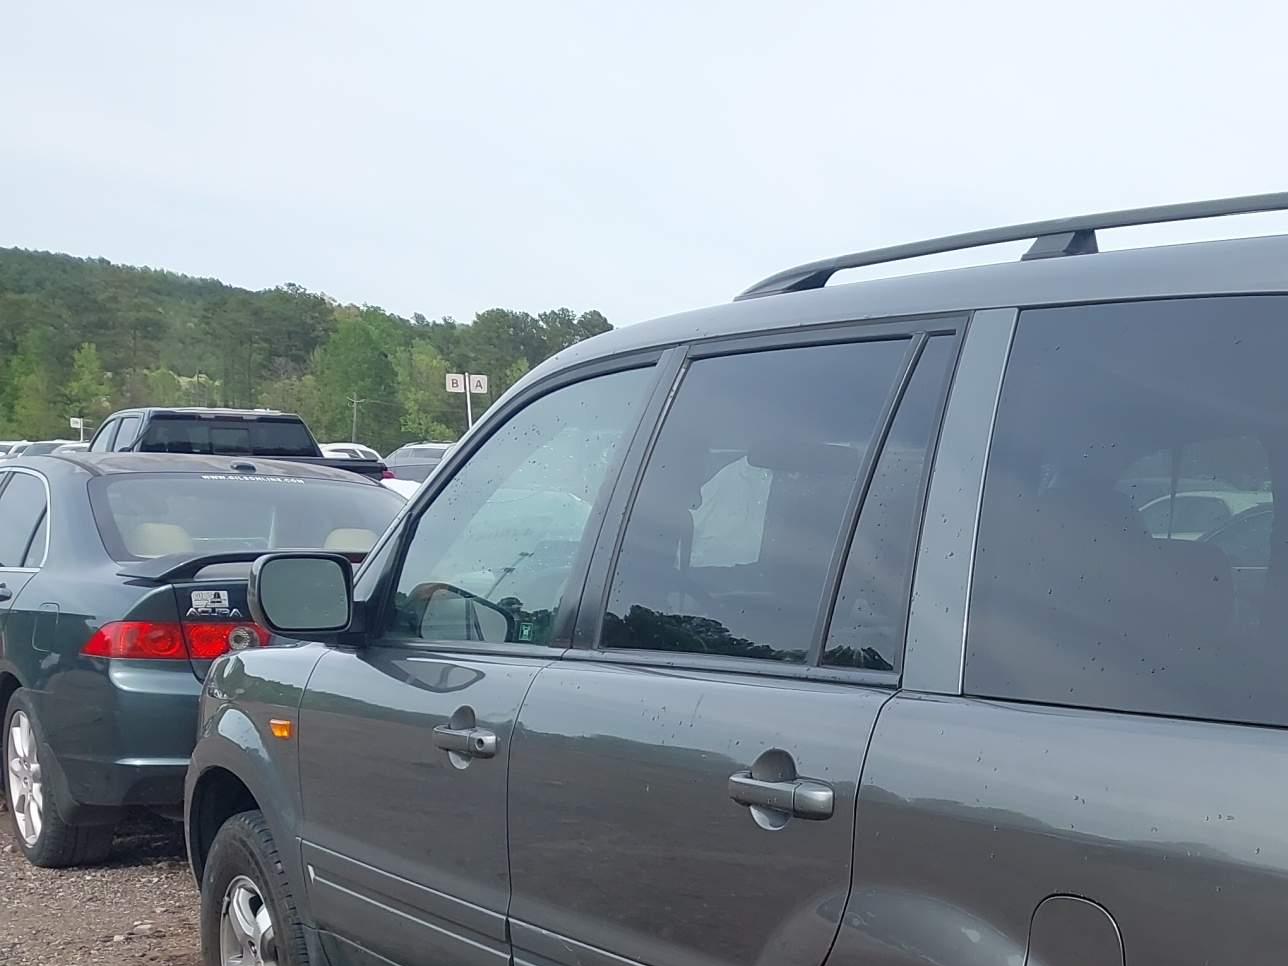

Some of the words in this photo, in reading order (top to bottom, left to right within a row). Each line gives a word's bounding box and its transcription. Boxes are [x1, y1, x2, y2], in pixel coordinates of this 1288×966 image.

[451, 378, 459, 389] B
[475, 379, 483, 390] A
[185, 607, 243, 617] ACURA
